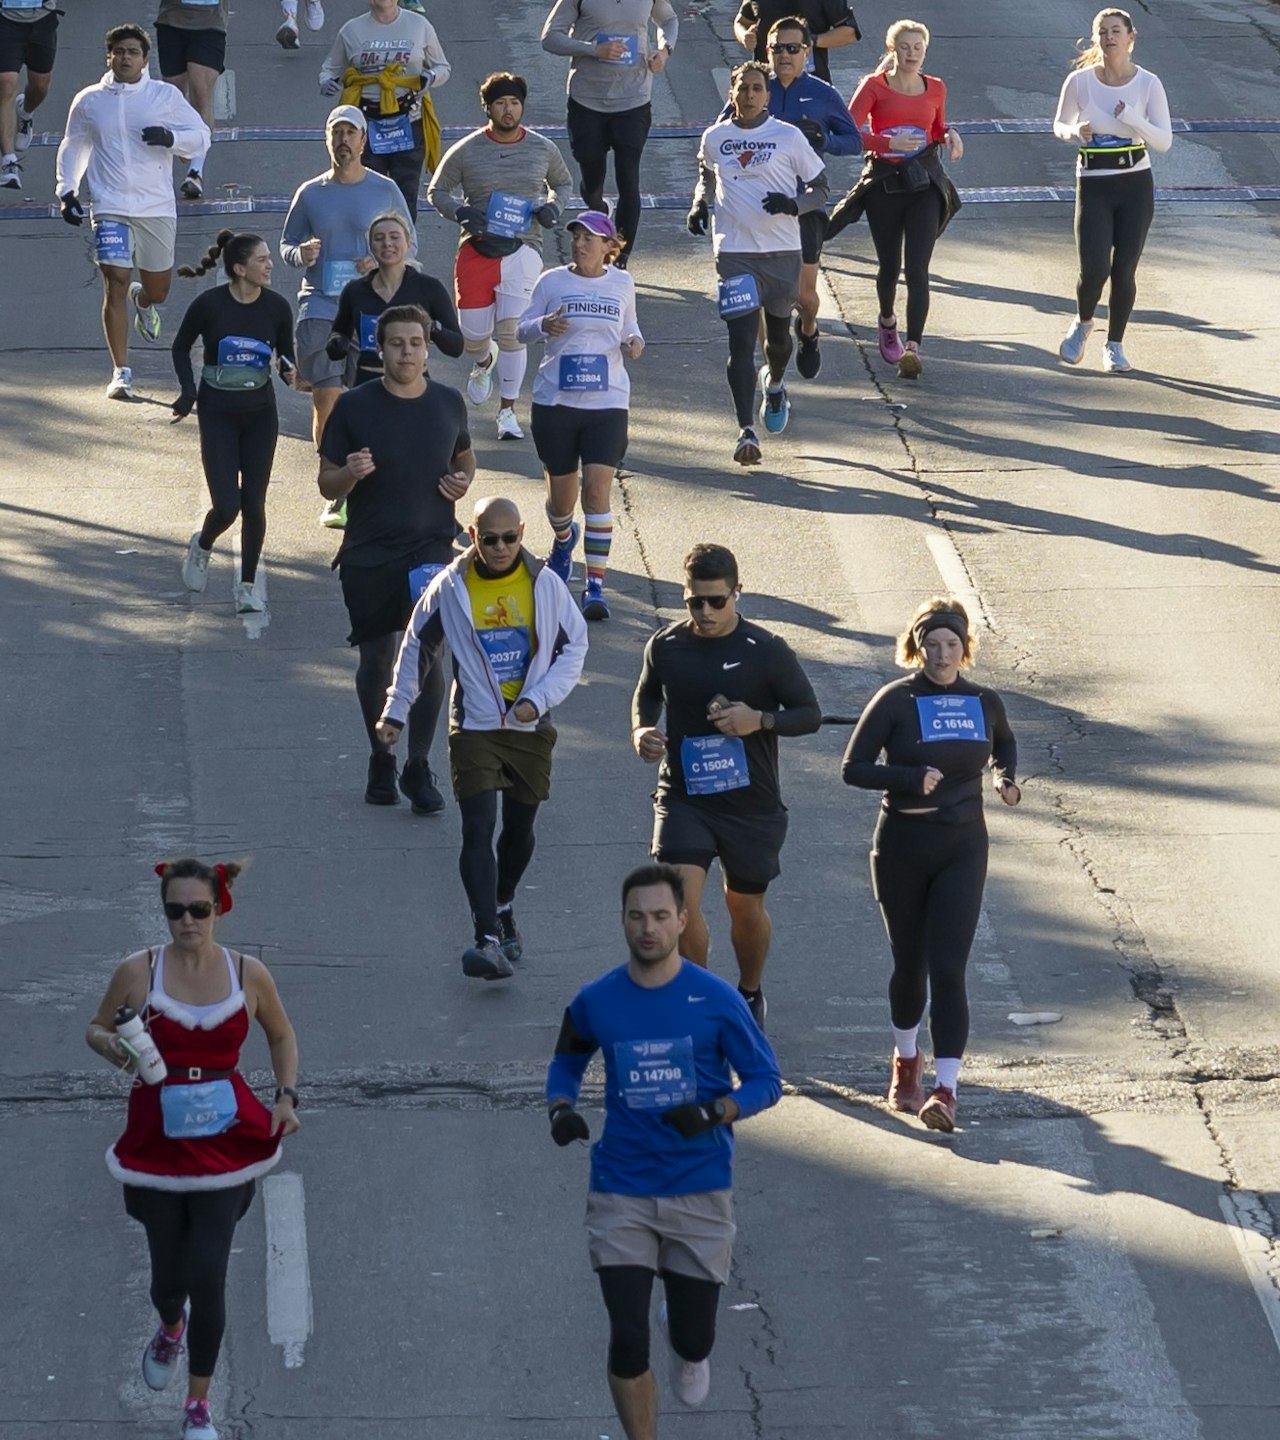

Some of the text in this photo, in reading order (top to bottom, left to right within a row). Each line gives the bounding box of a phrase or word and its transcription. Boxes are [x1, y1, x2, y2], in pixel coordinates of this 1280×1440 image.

[720, 139, 777, 156] Cowtown
[567, 303, 621, 317] FINISHER
[368, 334, 375, 343] C
[490, 650, 522, 663] 20377
[932, 719, 975, 730] C 16148
[691, 758, 735, 773] C 15024
[630, 1068, 682, 1082] D 14798
[184, 1113, 194, 1124] A
